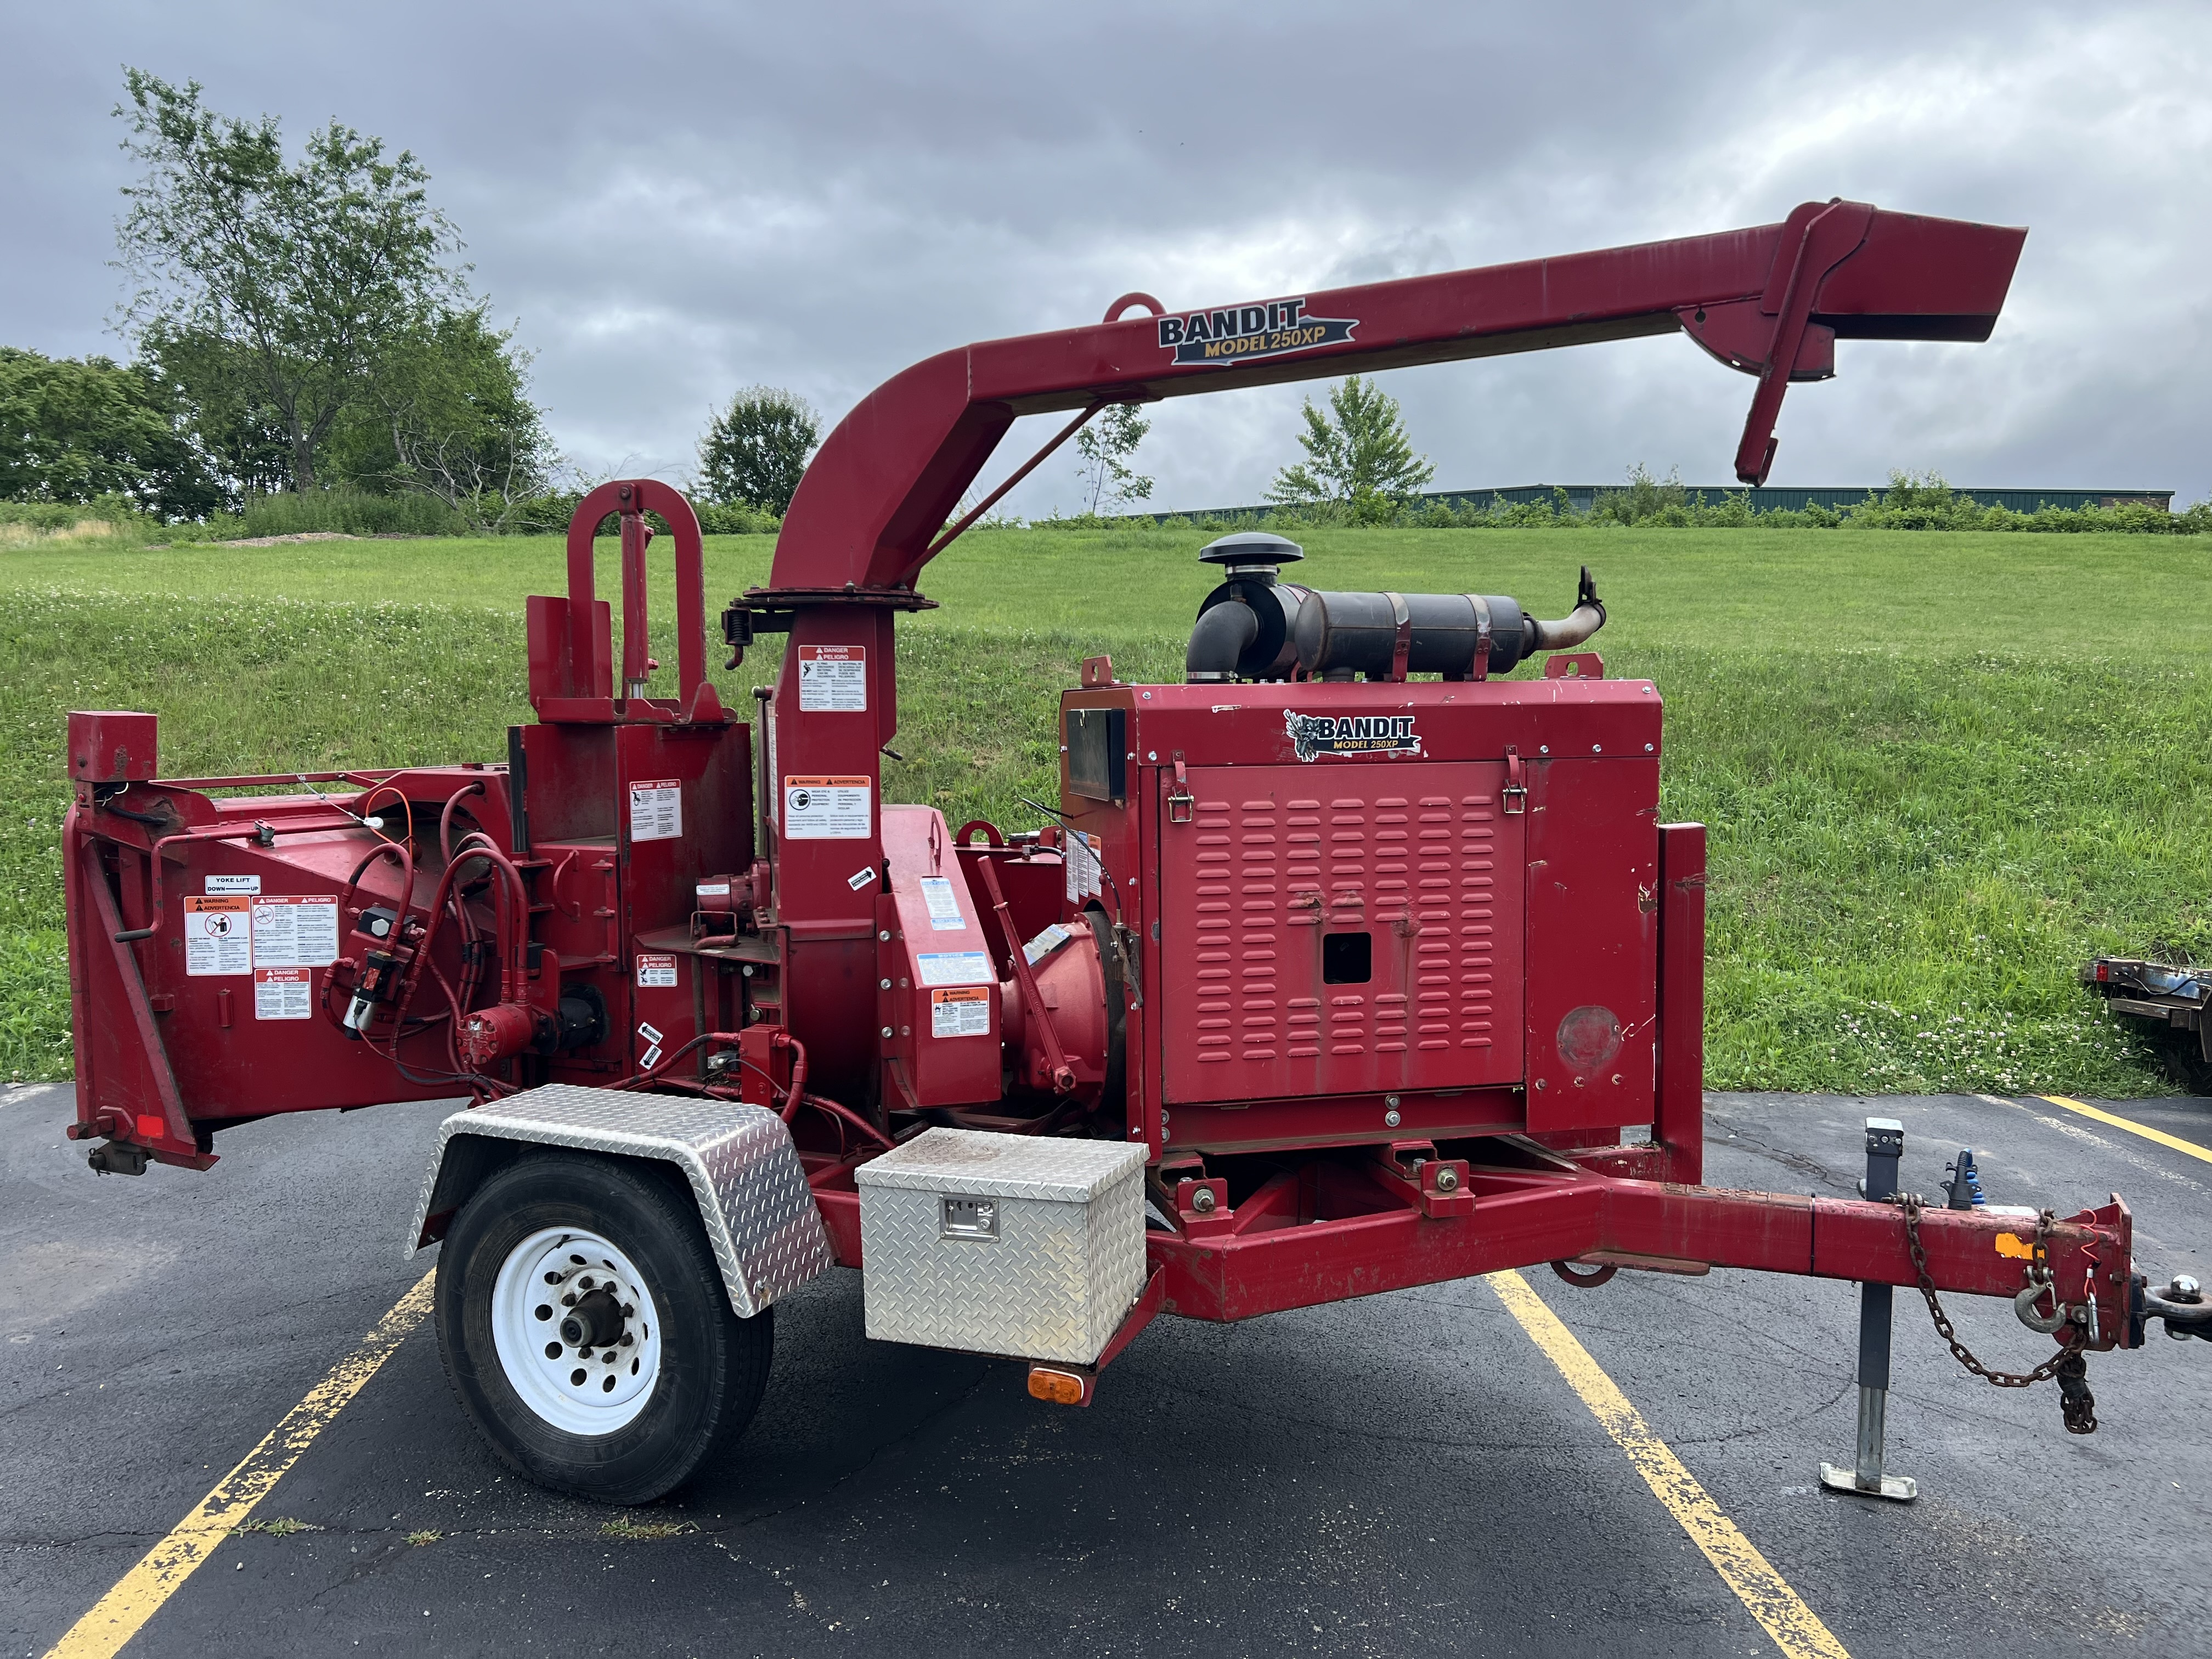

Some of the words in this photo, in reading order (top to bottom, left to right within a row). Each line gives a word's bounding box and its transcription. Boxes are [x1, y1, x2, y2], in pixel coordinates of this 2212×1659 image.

[1159, 300, 1305, 347] BANDIT
[1205, 335, 1267, 358] MODEL
[1271, 326, 1327, 349] 250XP
[1318, 717, 1414, 739] BANDIT
[1333, 740, 1369, 749] MODEL
[1371, 740, 1398, 748] 250XP
[514, 1440, 608, 1485] DA802
